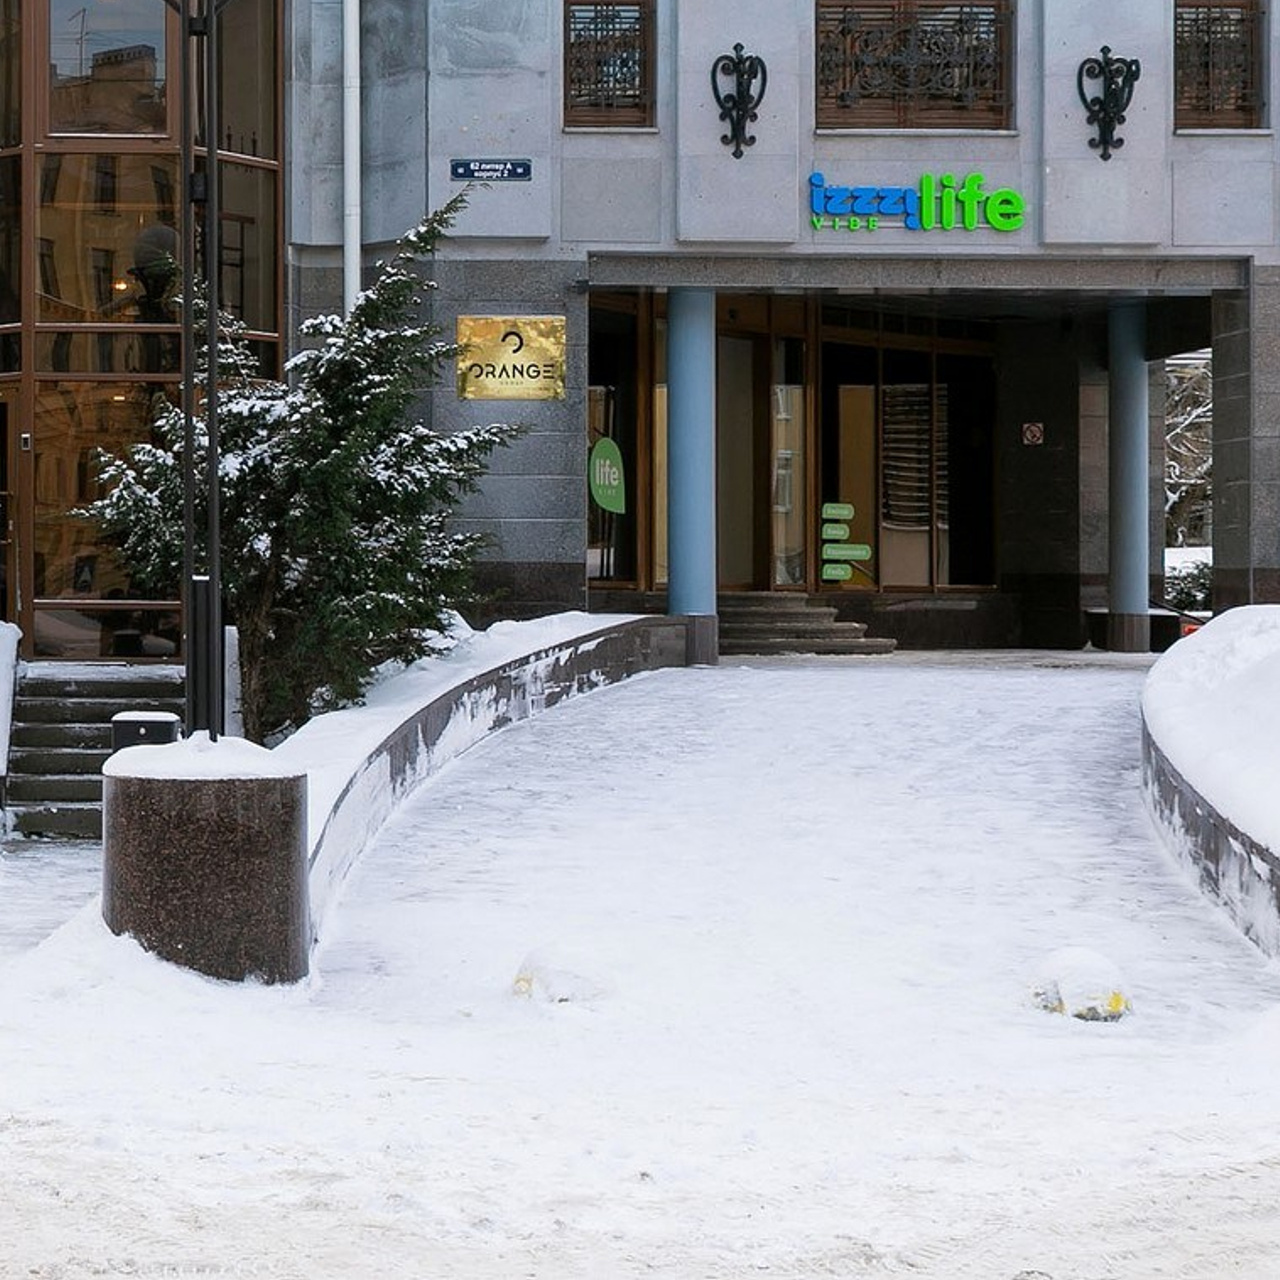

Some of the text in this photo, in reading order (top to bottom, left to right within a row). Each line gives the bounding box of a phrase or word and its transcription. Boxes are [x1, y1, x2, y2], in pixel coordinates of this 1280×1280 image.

[812, 217, 878, 230] VIBE
[468, 363, 555, 379] ORANGE
[596, 459, 619, 486] life
